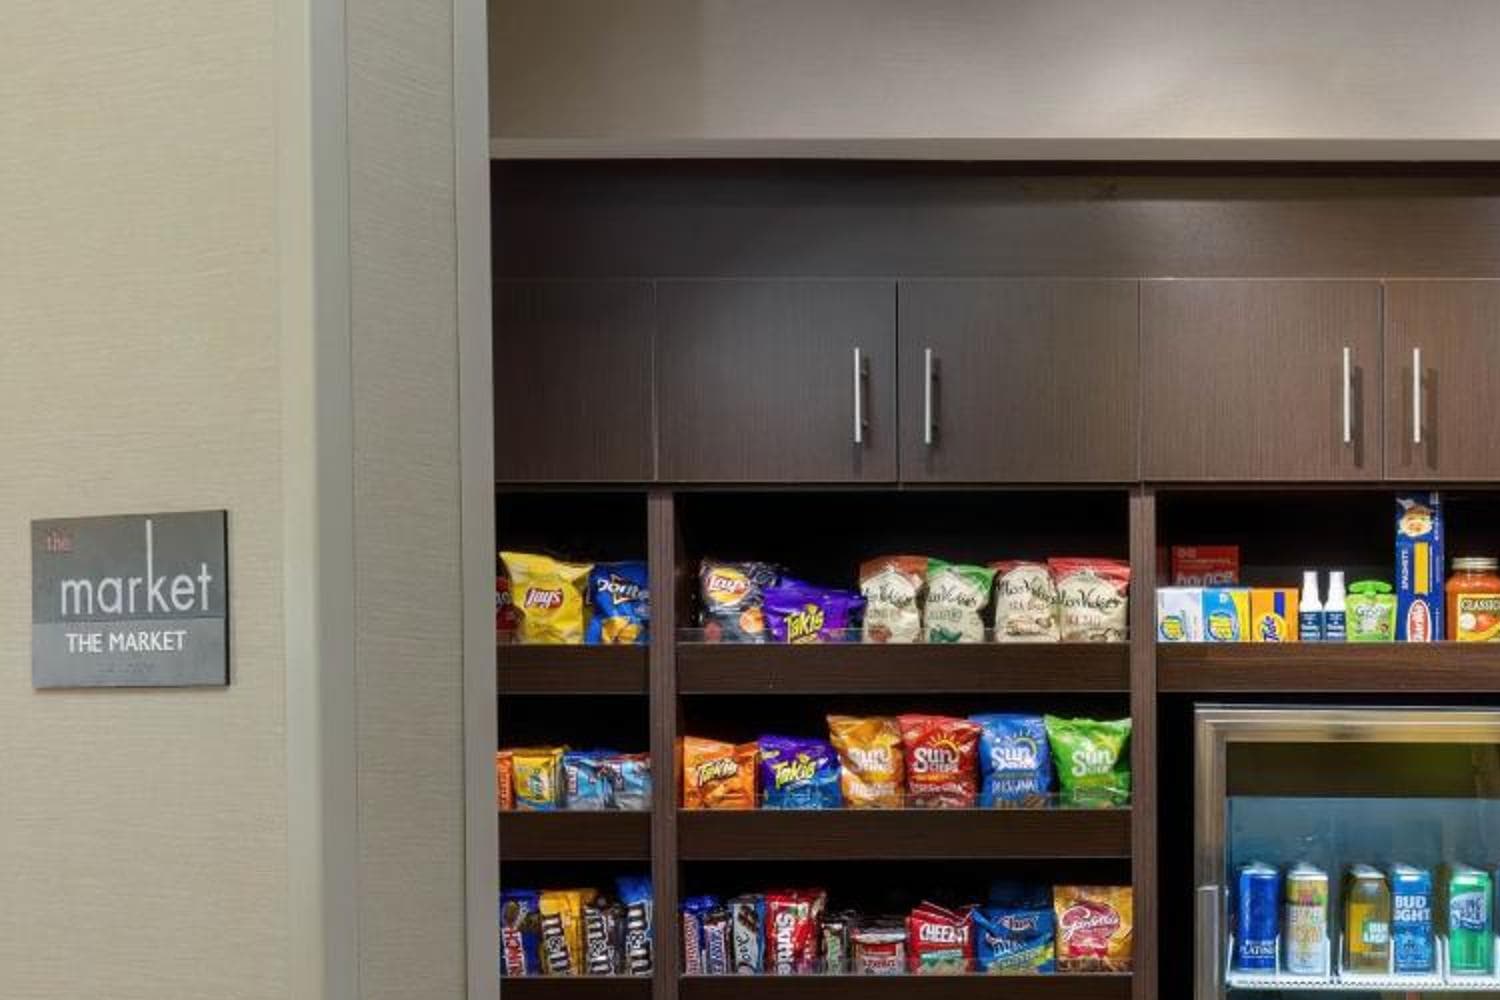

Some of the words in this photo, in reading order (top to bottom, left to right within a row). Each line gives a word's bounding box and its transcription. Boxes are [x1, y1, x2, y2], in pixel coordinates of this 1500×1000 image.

[61, 519, 212, 616] market
[65, 633, 102, 653] THE
[109, 630, 187, 652] MARKET
[913, 747, 953, 773] Sun
[1395, 895, 1427, 908] BUD
[776, 912, 796, 976] Skittle
